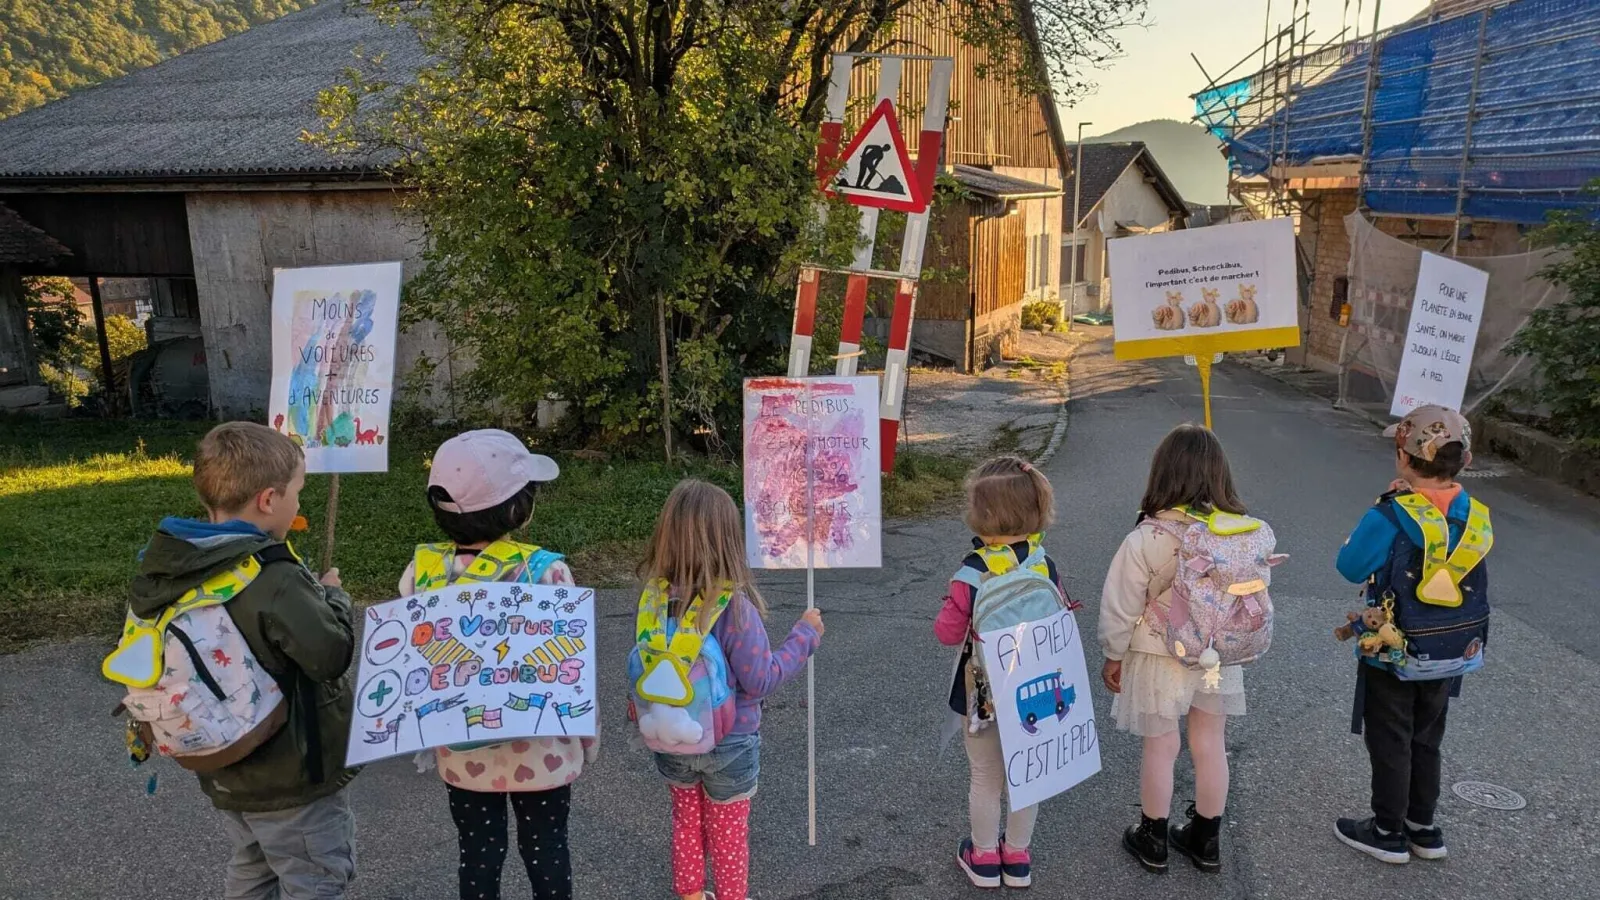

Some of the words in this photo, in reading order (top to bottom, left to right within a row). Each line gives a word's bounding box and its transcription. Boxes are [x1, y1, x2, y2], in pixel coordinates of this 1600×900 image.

[1145, 278, 1187, 289] l'important
[1189, 275, 1208, 284] c'est
[1209, 274, 1220, 282] de
[1221, 271, 1254, 281] marcher
[1158, 267, 1191, 276] Pedibus,
[312, 298, 363, 320] MOINS
[325, 330, 336, 340] de
[817, 436, 871, 451] MOTEUR
[411, 617, 453, 647] DE
[1032, 613, 1074, 662] PIED
[405, 664, 452, 696] DE
[1008, 738, 1055, 788] C'EST
